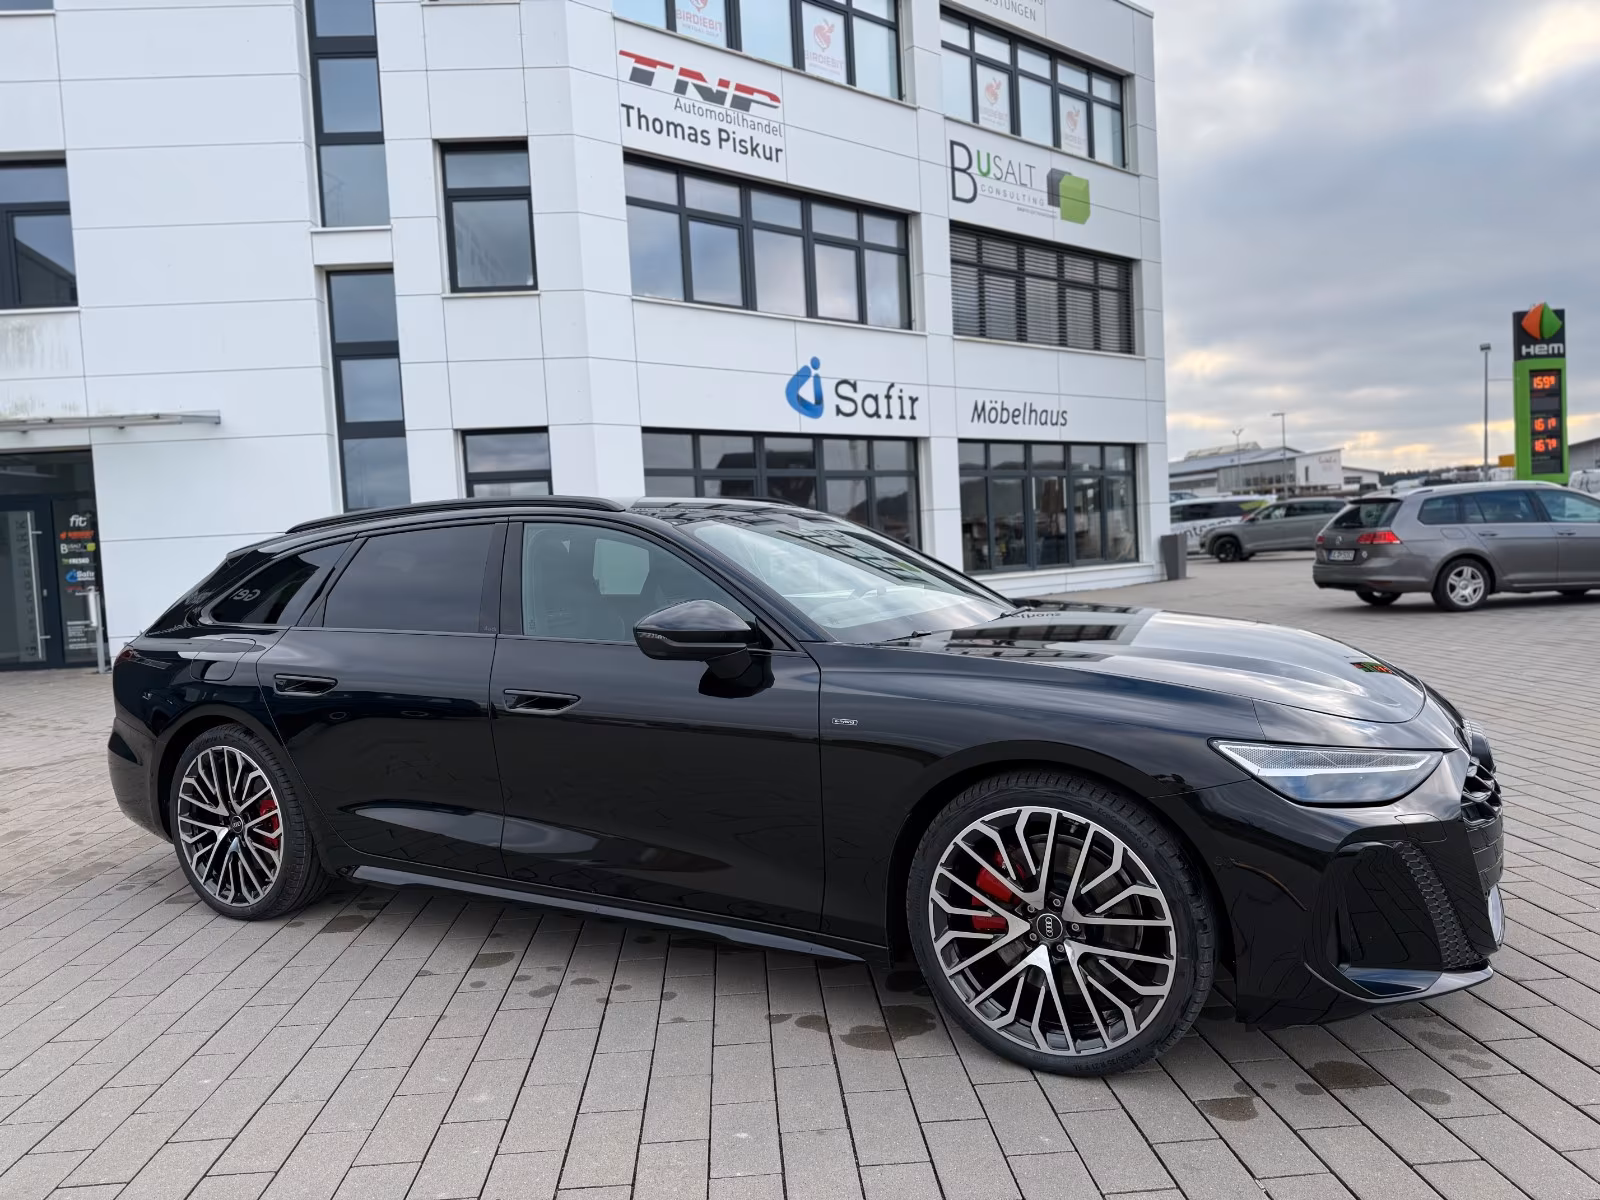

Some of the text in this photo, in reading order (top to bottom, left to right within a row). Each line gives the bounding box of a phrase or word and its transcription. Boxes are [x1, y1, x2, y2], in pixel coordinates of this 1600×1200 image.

[676, 9, 722, 33] BIRDIEBIT
[618, 50, 781, 112] TNP
[621, 103, 783, 163] Thomas Piskur
[673, 97, 783, 138] Automobilhandel
[950, 139, 1036, 204] BUSALT
[981, 183, 1045, 207] CONSULTING
[834, 379, 919, 421] Safir
[971, 400, 1068, 427] Möbelhaus
